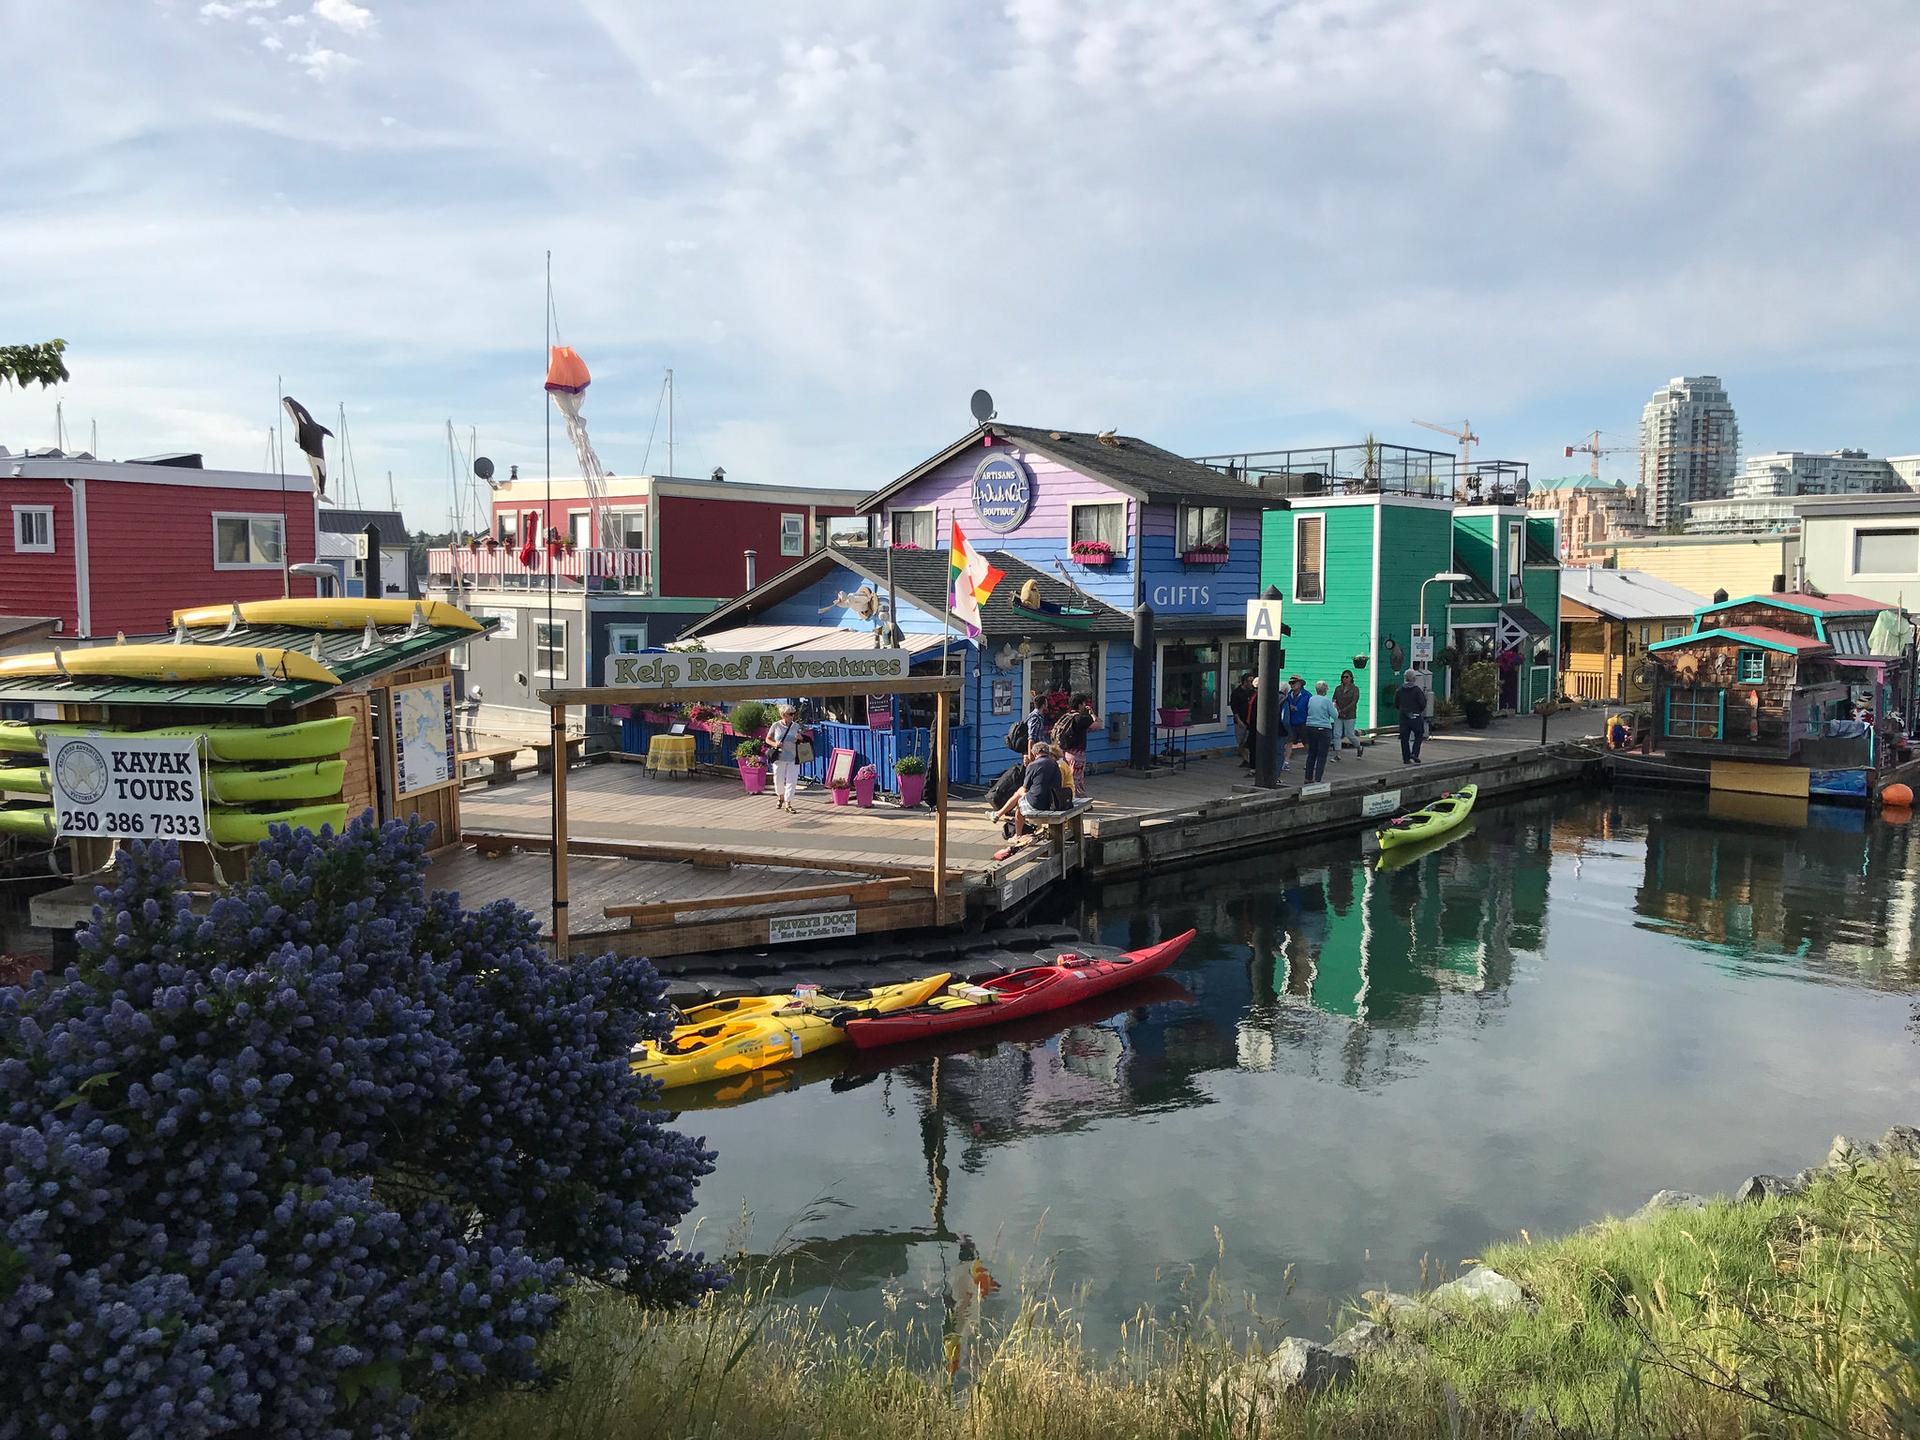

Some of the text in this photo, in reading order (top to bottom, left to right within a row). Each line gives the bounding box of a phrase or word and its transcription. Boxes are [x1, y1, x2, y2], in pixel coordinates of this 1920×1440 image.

[982, 471, 1016, 480] ARTISANS
[983, 507, 1016, 516] BOUTIQUE
[359, 538, 366, 556] B
[1153, 586, 1210, 605] GIFTS
[1253, 608, 1273, 636] A
[614, 654, 901, 688] Kelp Reef Adventures
[112, 751, 192, 774] KAYAK
[114, 778, 194, 802] TOURS
[62, 811, 200, 835] 250 386 7333
[771, 913, 855, 931] PRIVATE DOCK
[808, 927, 831, 936] Public
[832, 926, 845, 934] Use
